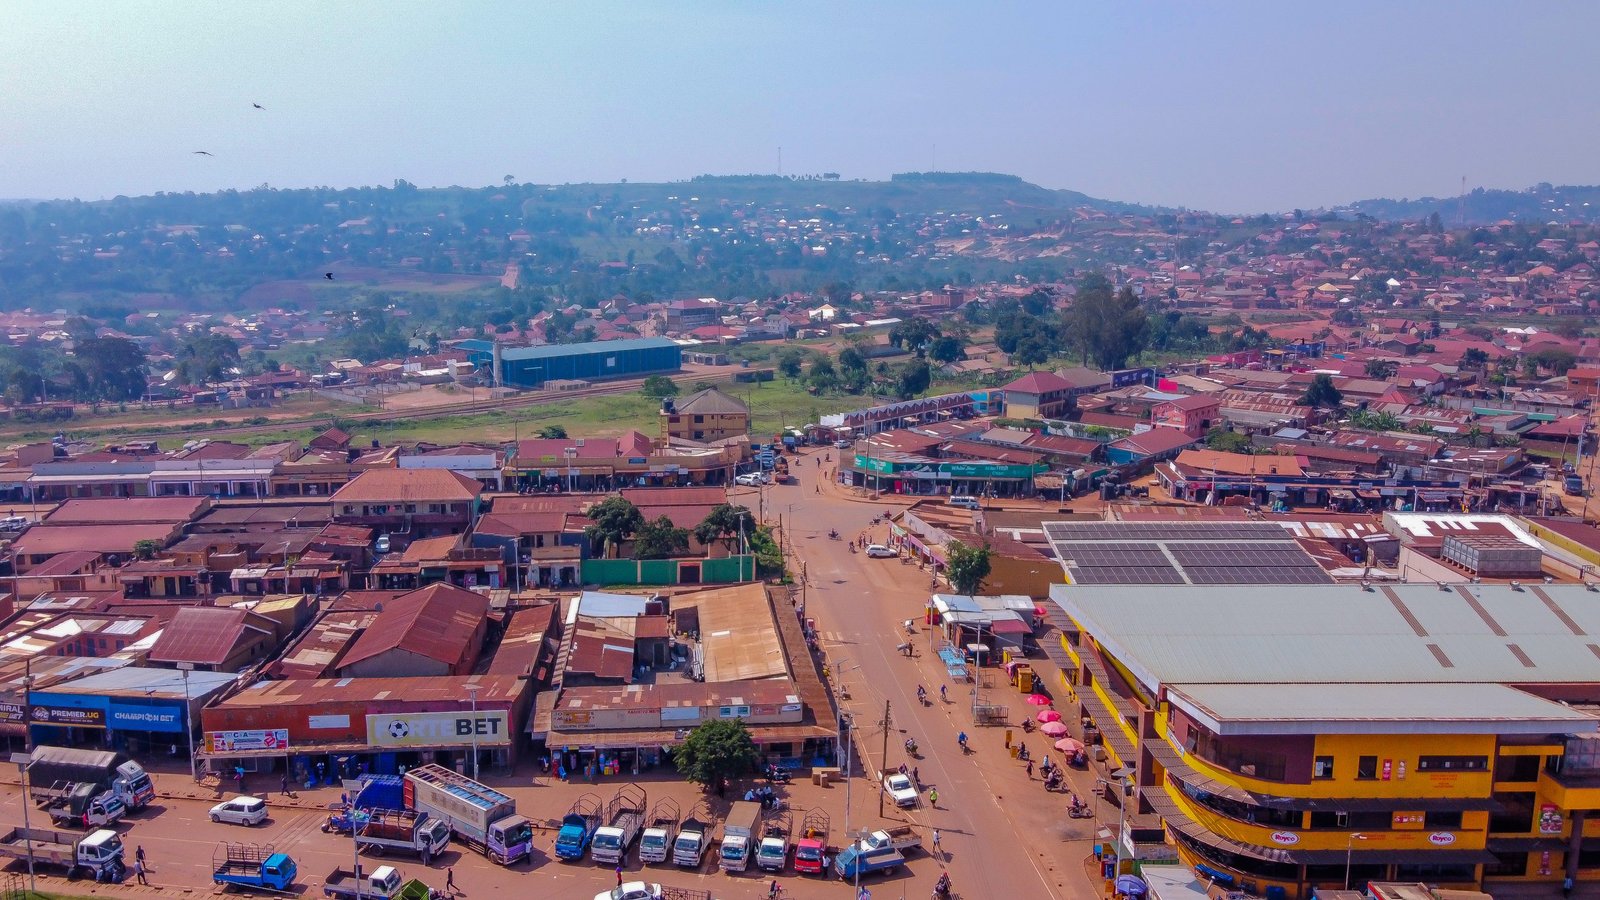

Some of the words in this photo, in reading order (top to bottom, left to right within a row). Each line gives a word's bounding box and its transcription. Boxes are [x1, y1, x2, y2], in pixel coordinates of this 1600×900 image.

[51, 709, 99, 719] PREMIER.UG
[160, 714, 175, 722] BET
[1275, 834, 1296, 842] Royco
